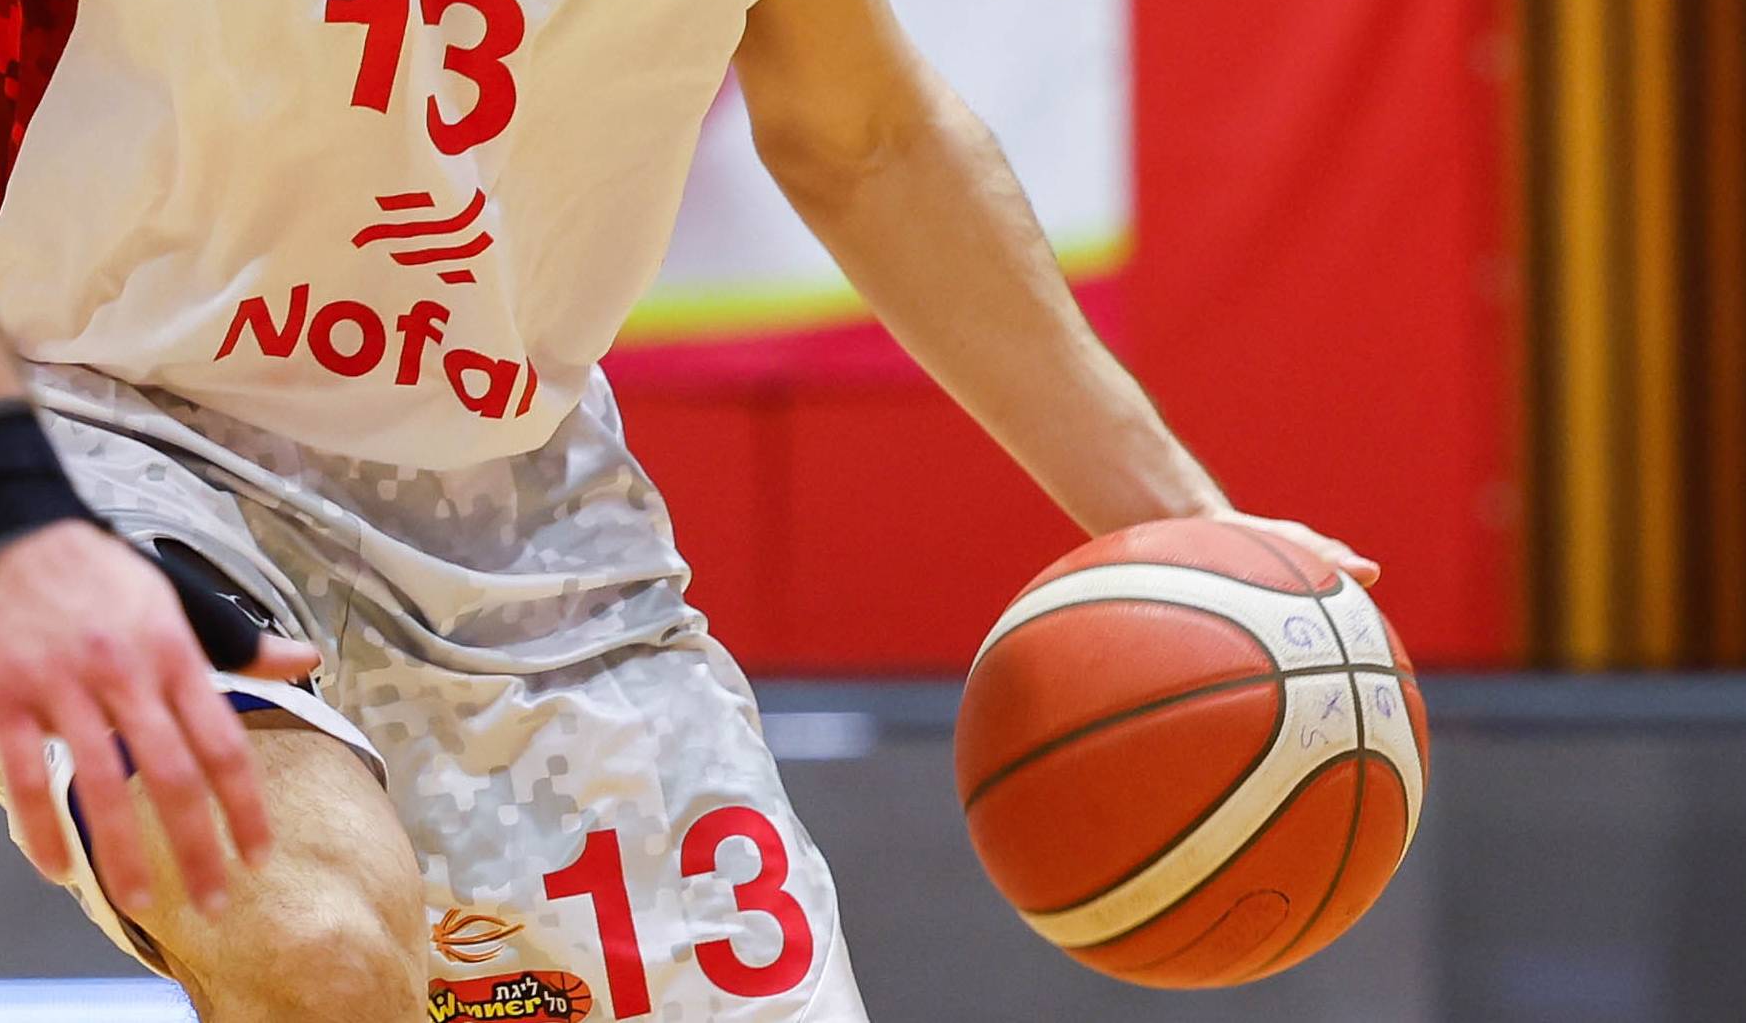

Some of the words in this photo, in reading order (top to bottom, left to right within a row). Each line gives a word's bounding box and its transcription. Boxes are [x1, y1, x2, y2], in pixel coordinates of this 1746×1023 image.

[542, 805, 815, 1021] 13
[495, 976, 539, 1001] ליגת
[543, 990, 568, 1013] סל
